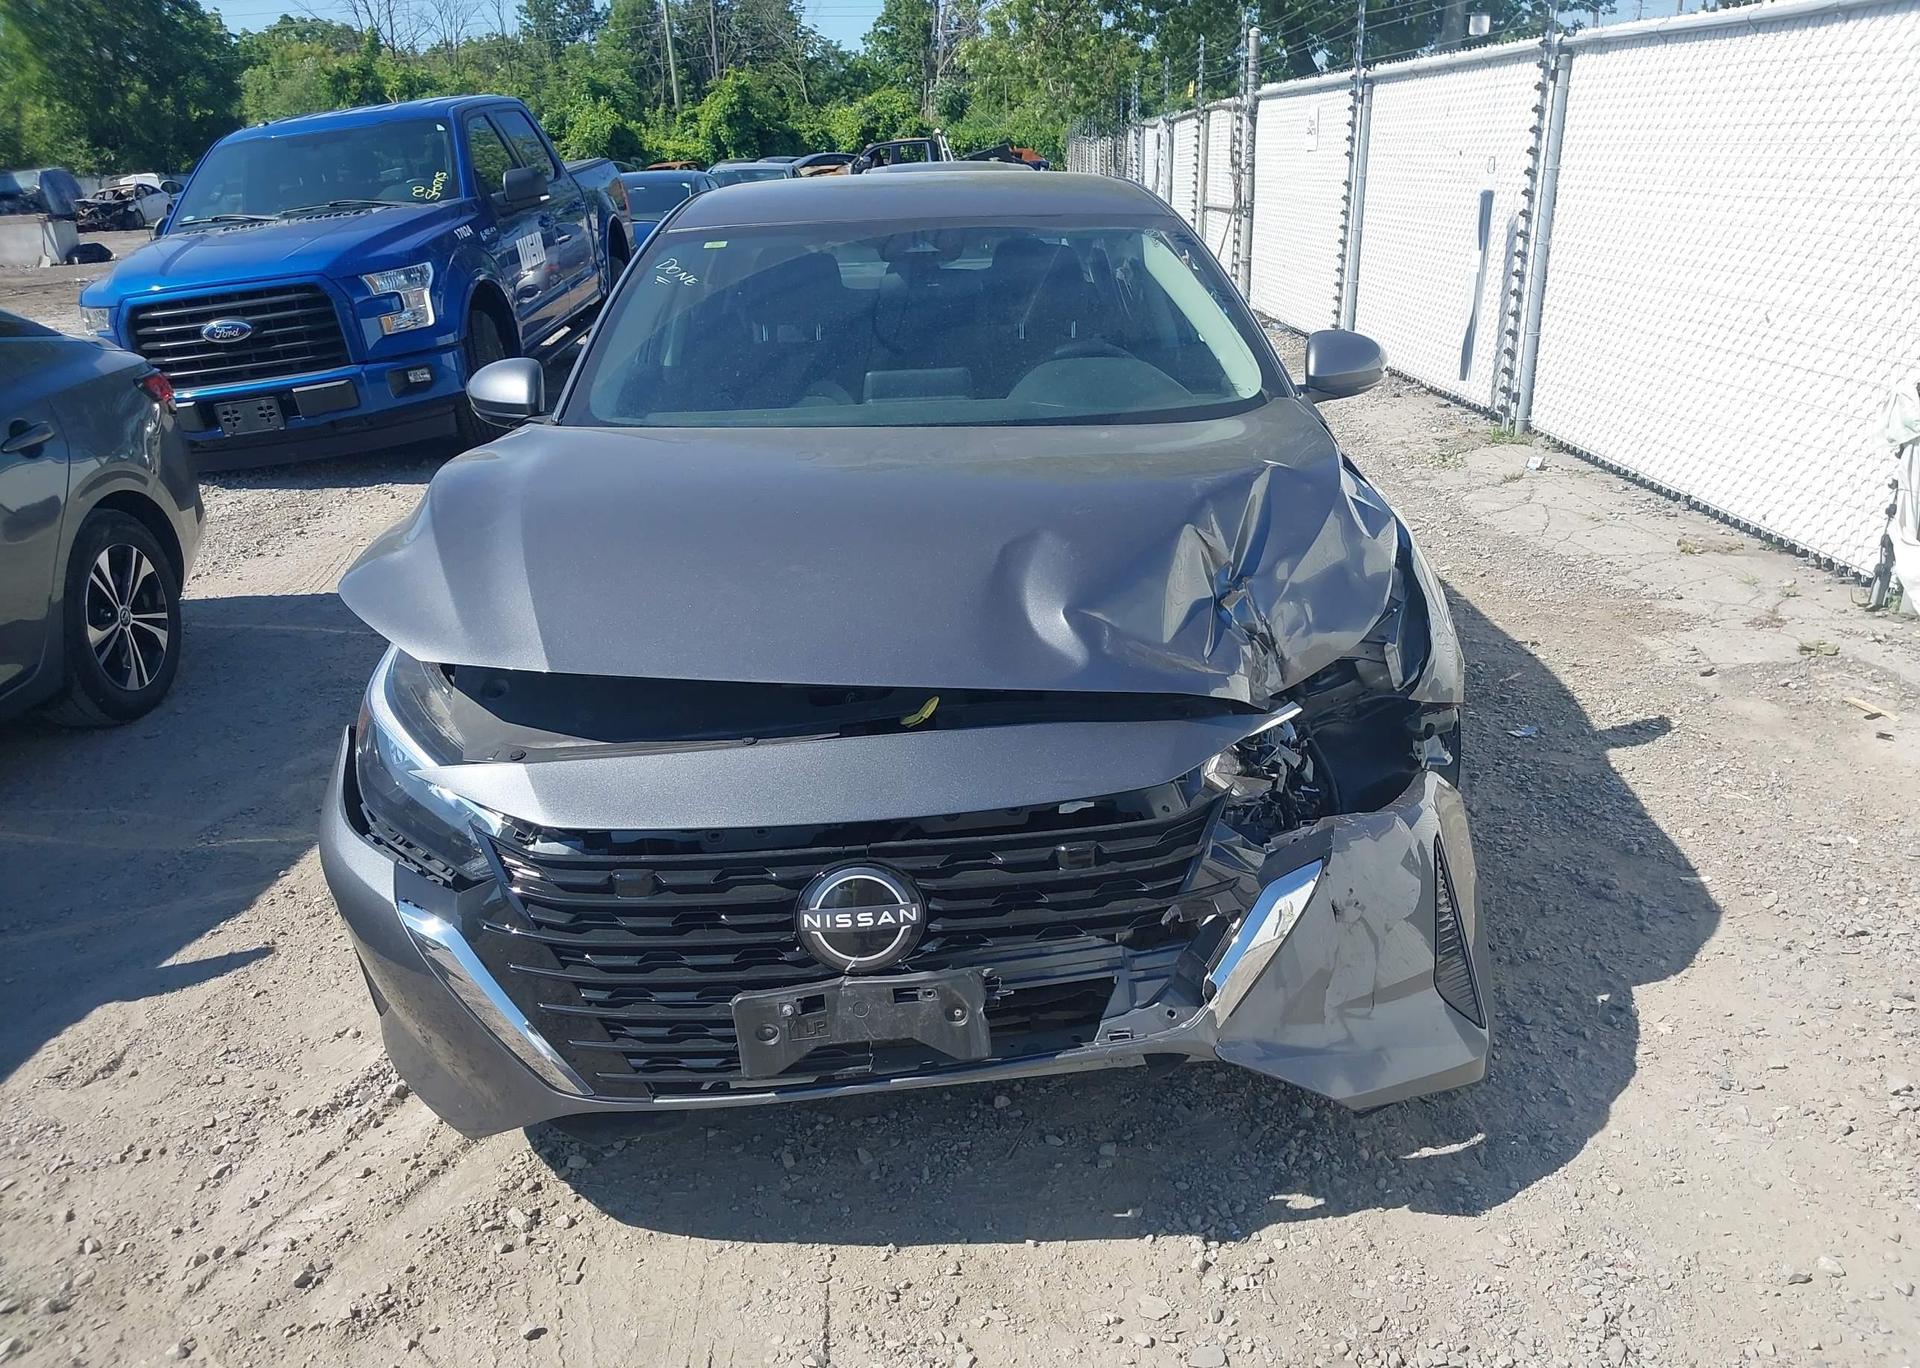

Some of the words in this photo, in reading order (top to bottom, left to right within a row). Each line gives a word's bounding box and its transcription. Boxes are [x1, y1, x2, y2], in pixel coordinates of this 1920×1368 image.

[655, 258, 699, 286] DONE
[213, 325, 240, 339] Ford
[803, 906, 917, 928] NISSAN
